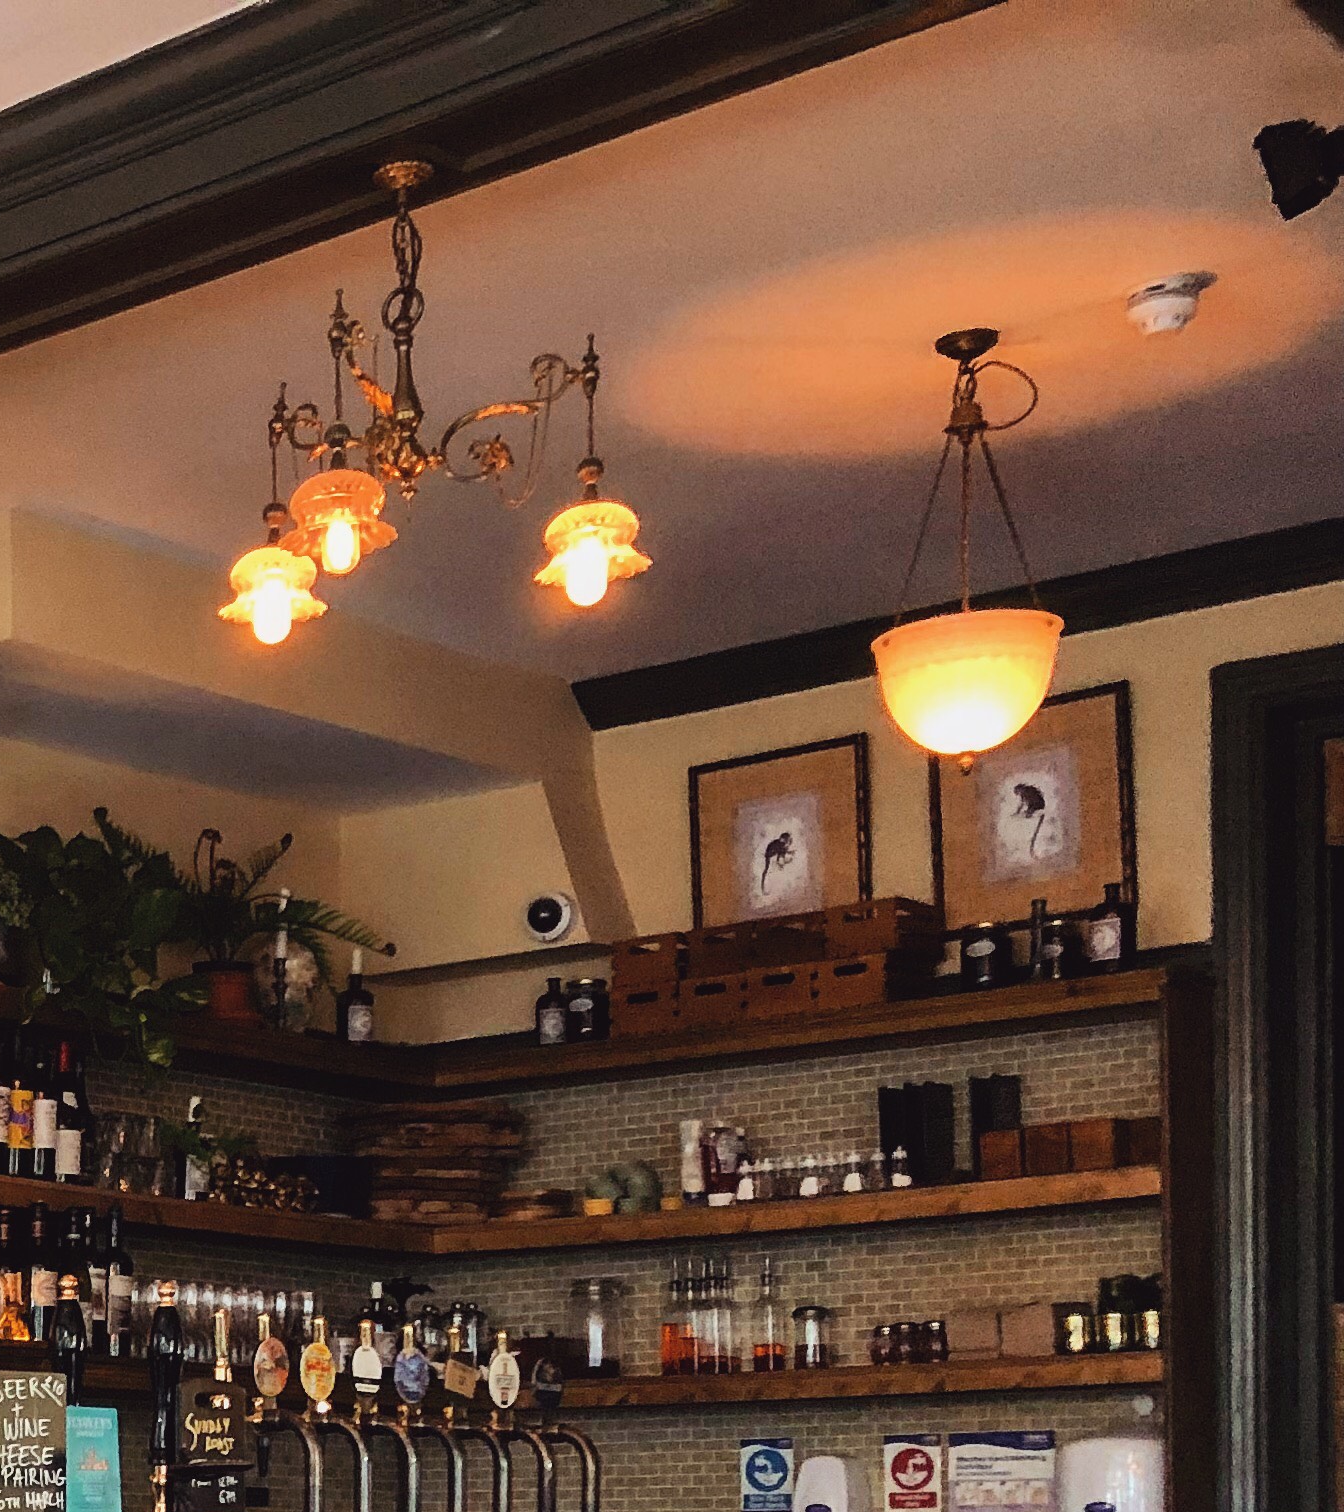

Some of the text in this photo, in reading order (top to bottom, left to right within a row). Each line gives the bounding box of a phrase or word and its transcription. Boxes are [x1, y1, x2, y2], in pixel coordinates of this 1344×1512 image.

[3, 1417, 52, 1441] WINE
[0, 1465, 67, 1488] PAIRING
[25, 1490, 65, 1511] MARCH
